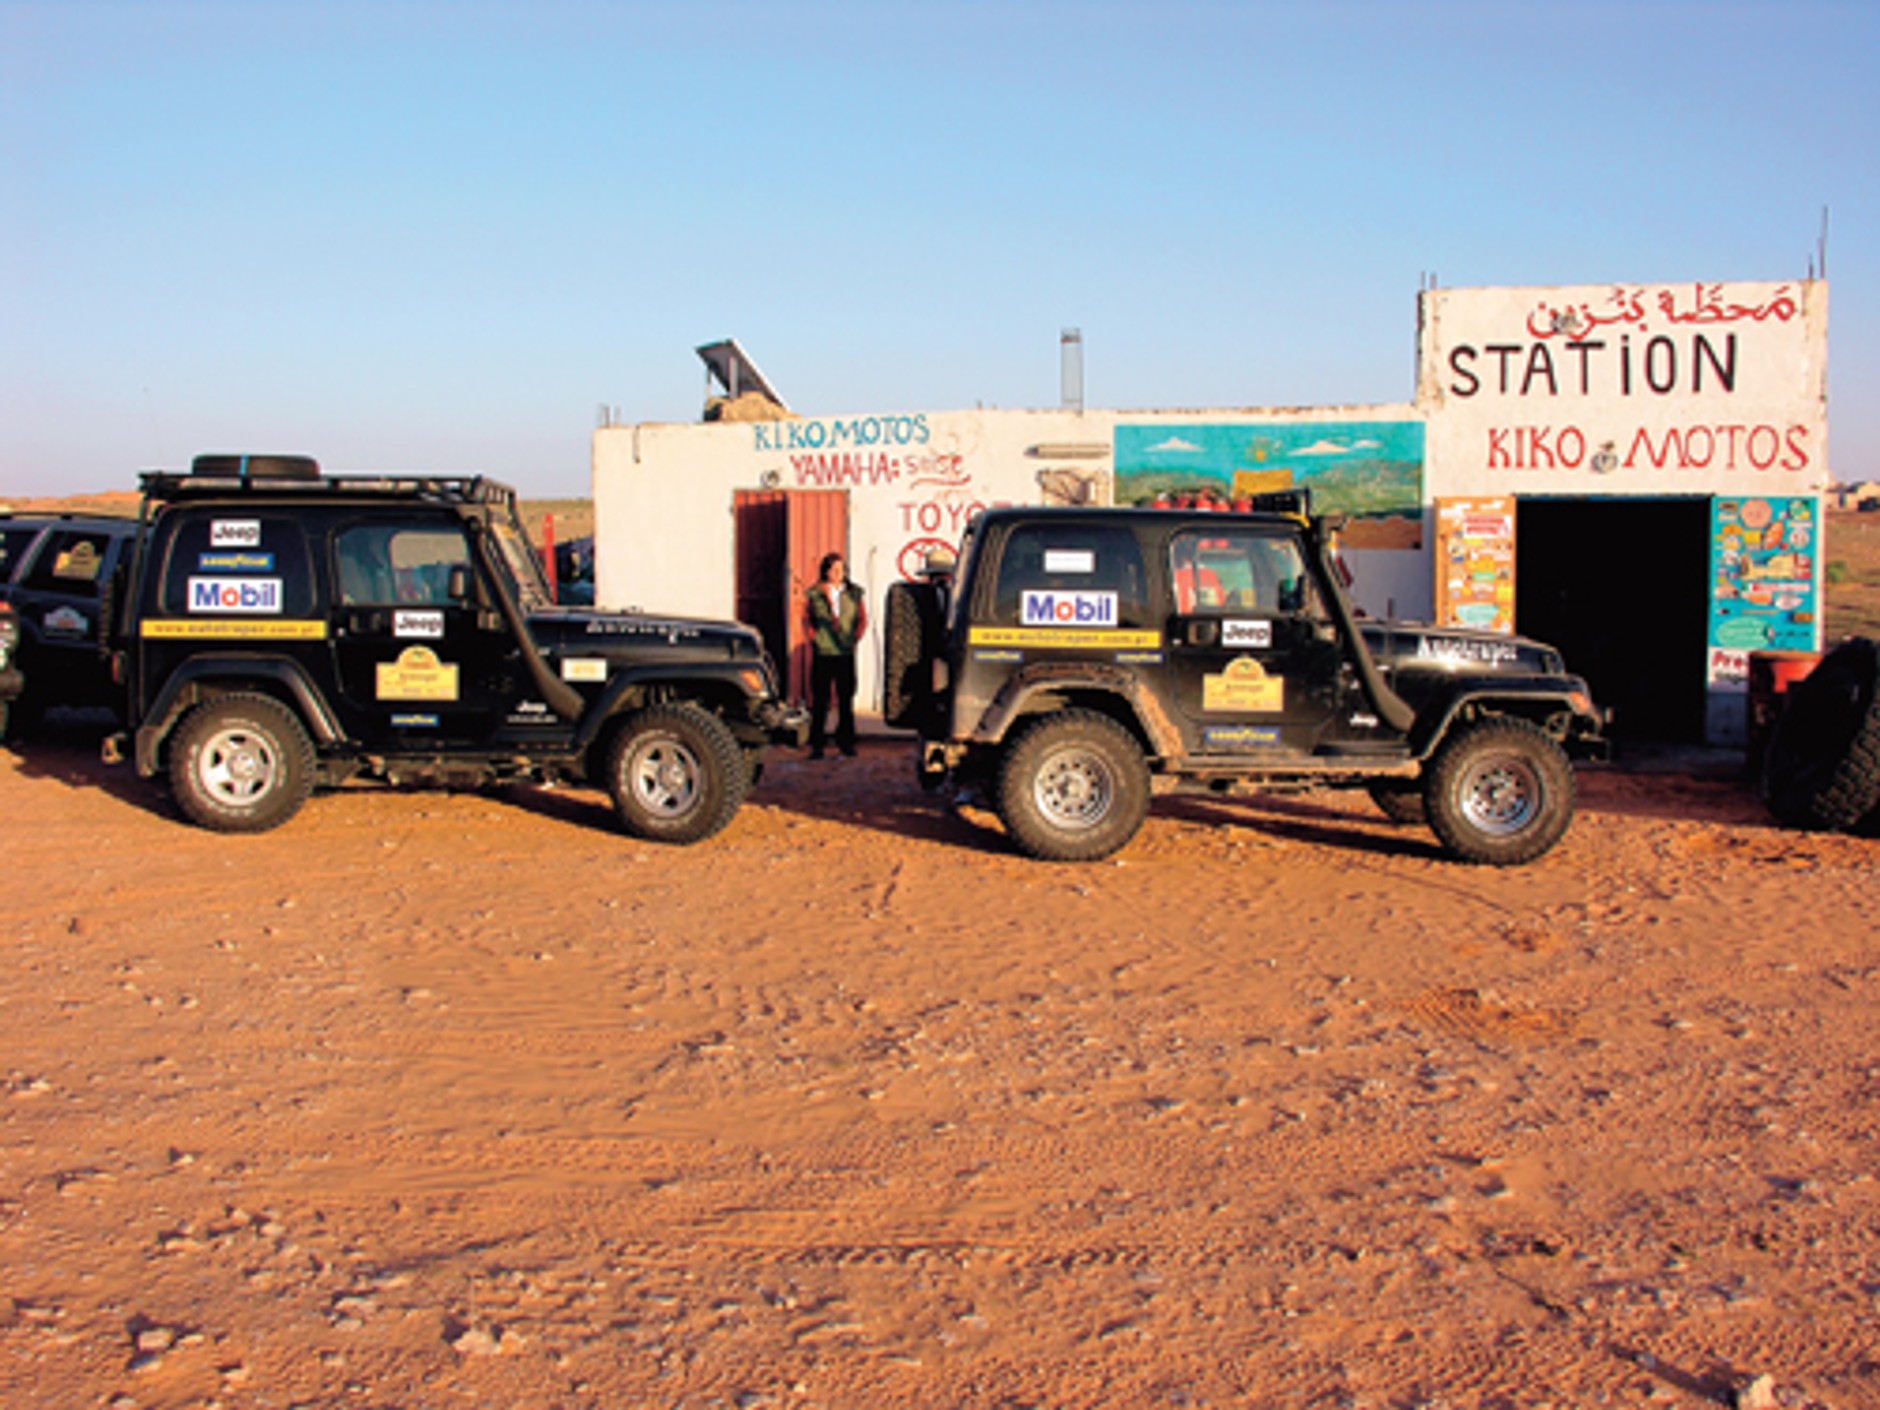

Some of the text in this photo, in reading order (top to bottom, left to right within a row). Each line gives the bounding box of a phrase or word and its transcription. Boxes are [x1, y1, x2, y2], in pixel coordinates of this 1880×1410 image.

[1487, 424, 1810, 472] KIKO MOTOS
[195, 582, 276, 607] Mobil
[1026, 594, 1111, 622] Mobil
